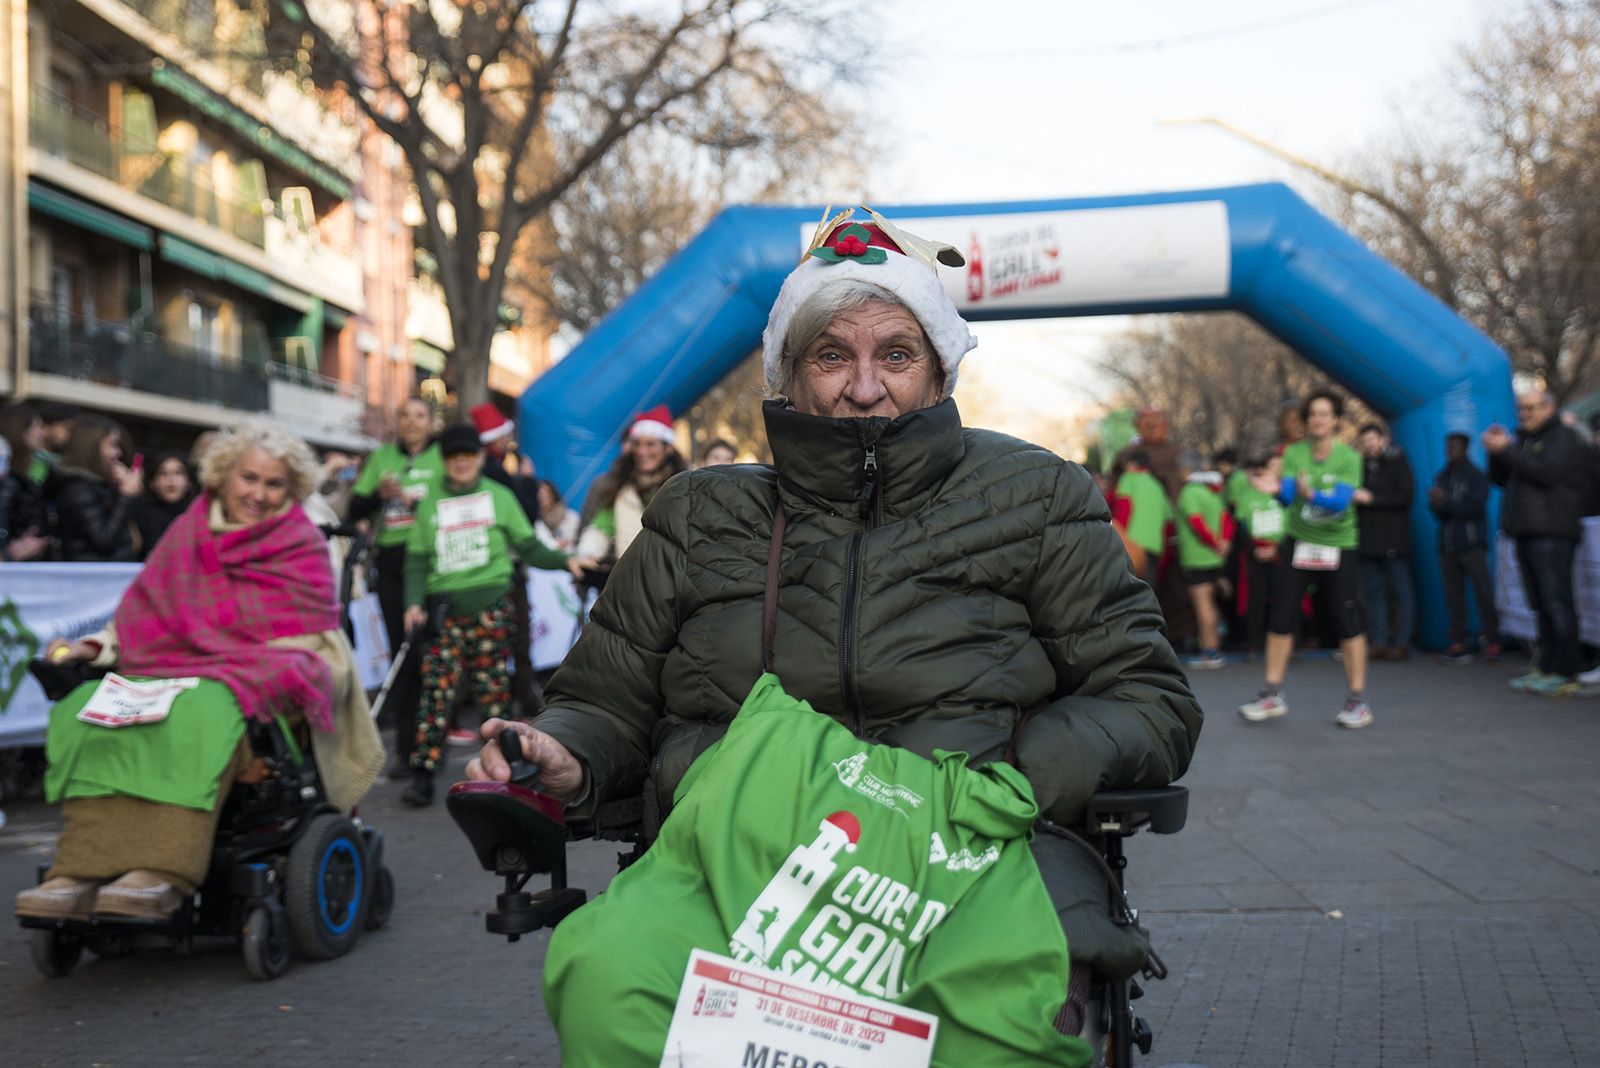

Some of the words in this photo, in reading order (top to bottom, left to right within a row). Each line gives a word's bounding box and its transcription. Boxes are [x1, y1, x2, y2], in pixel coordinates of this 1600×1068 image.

[832, 866, 920, 931] CURS
[756, 996, 769, 1012] 31
[770, 1000, 784, 1016] DE
[785, 1004, 840, 1032] DESEMBRE
[841, 1020, 856, 1036] DE
[858, 1024, 887, 1044] 2023
